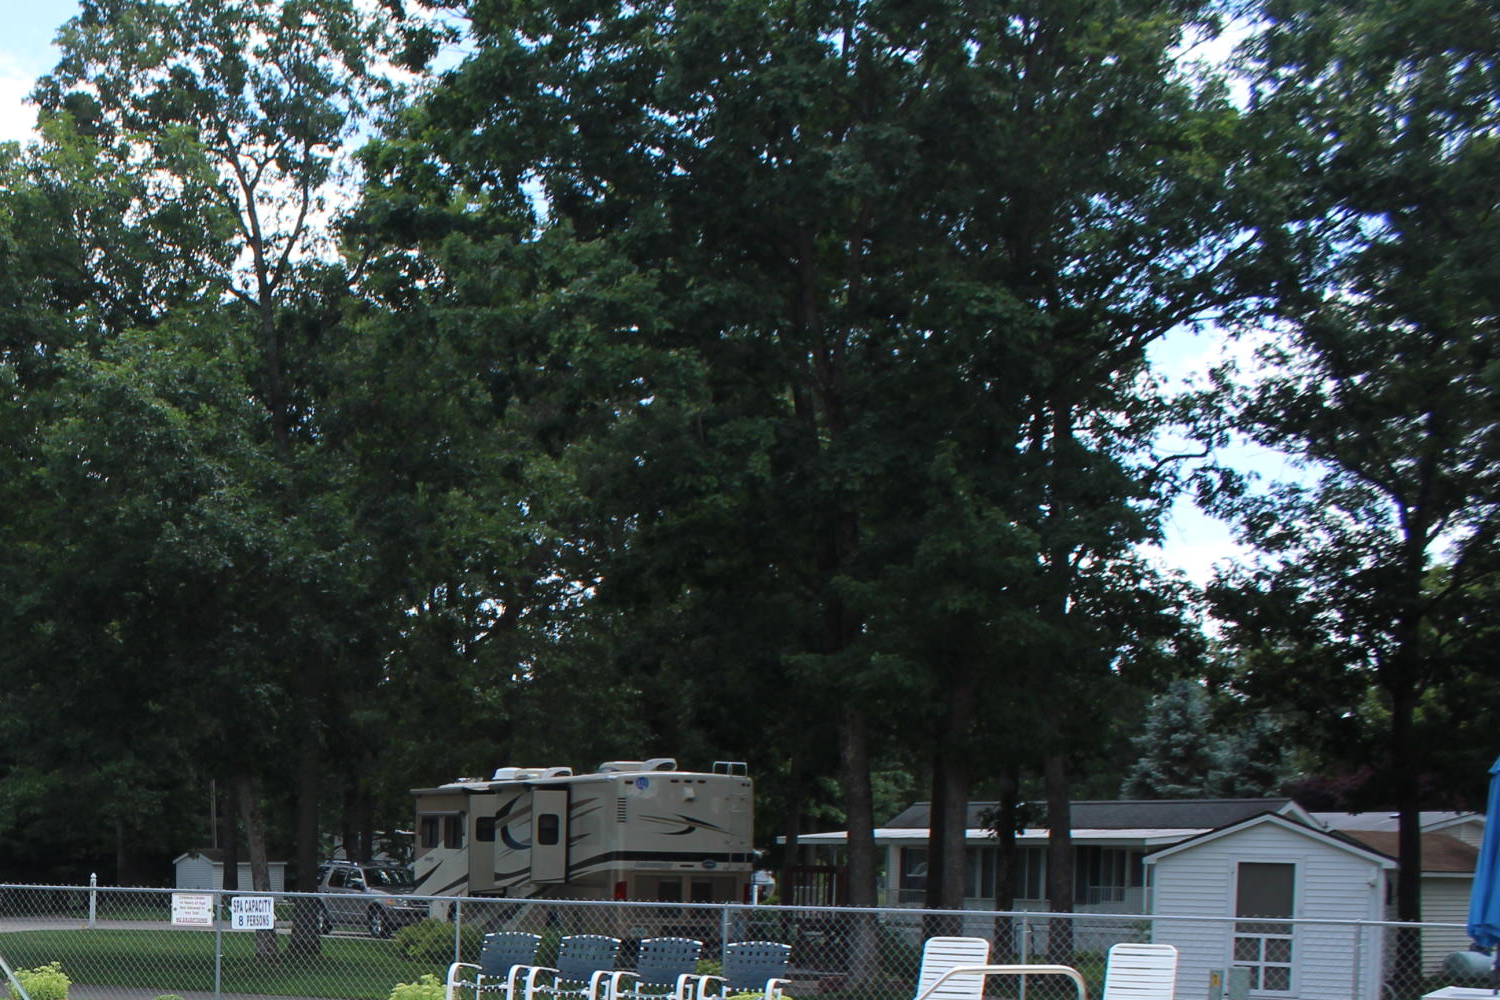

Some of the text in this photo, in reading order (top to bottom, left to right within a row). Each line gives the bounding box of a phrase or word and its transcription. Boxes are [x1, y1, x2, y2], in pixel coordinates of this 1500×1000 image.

[233, 899, 271, 913] SPA CAPACITY
[238, 915, 270, 927] 8 PERSONS
